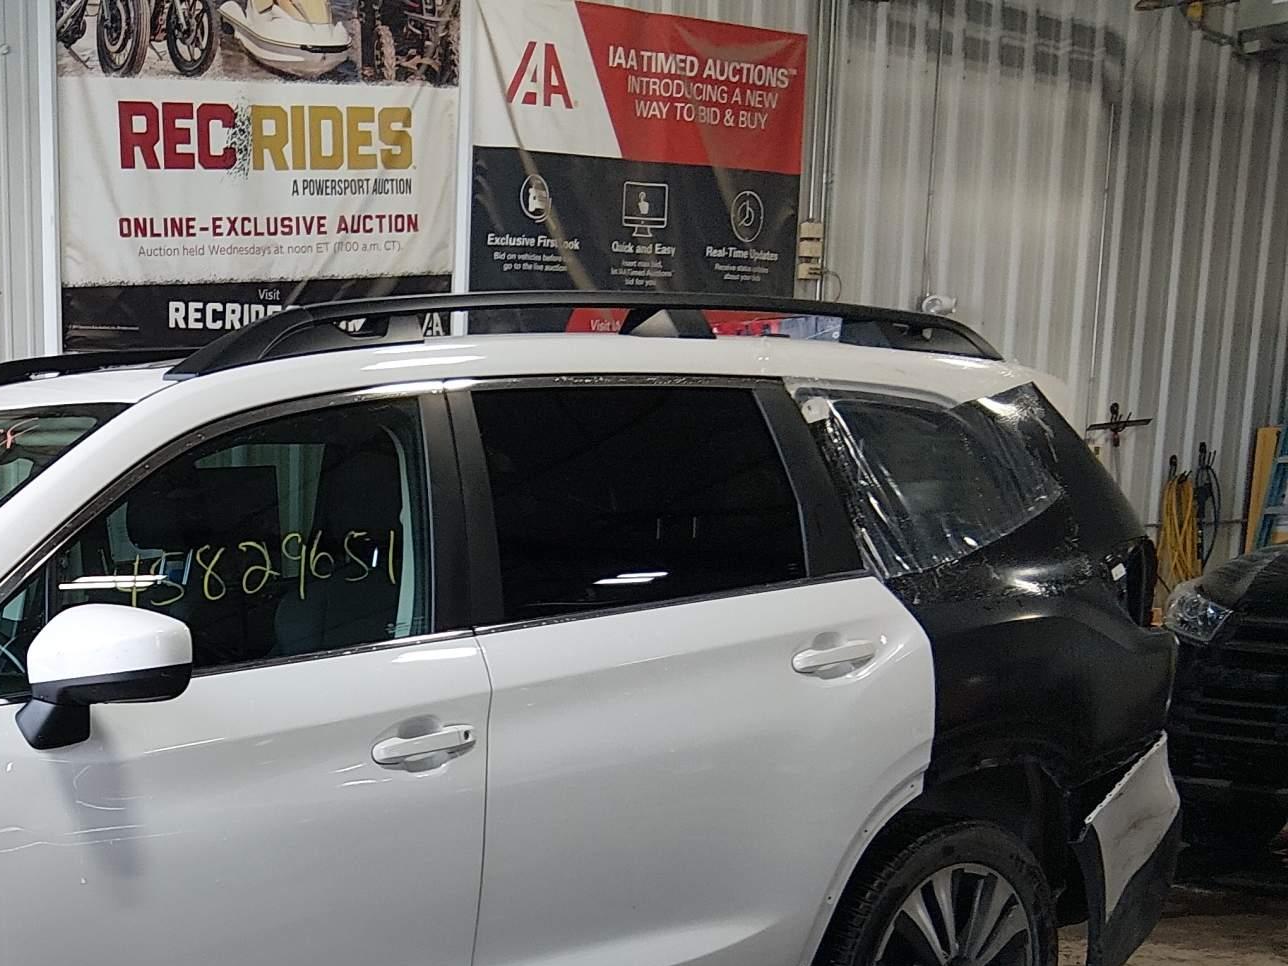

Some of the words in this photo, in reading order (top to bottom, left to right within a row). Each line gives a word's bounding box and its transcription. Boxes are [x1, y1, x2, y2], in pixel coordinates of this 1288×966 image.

[608, 46, 638, 70] IAA
[640, 51, 698, 77] TIMED
[627, 75, 728, 104] INTRODUCING
[731, 87, 742, 105] A
[745, 90, 779, 109] NEW
[635, 99, 671, 120] WAY
[674, 102, 696, 122] TO
[697, 106, 720, 125] BID
[723, 110, 735, 127] &
[739, 111, 768, 129] BUY
[249, 104, 414, 171] RIDES
[292, 178, 300, 196] A
[302, 178, 371, 196] POWERSPORT
[372, 178, 413, 195] AUCTION
[118, 215, 328, 238] ONLINE-EXCLUSIVE
[336, 214, 420, 234] AUCTION
[138, 245, 179, 257] Auction
[182, 244, 205, 256] held
[209, 243, 272, 257] Wednesdays
[273, 245, 283, 255] at
[287, 245, 313, 254] noon
[316, 242, 330, 253] ET
[487, 233, 536, 247] Exclusive
[562, 238, 580, 250] ook
[611, 240, 634, 253] Quick
[636, 243, 653, 254] and
[655, 243, 676, 257] Easy
[705, 246, 749, 259] Real-Time
[749, 249, 779, 261] Updates
[258, 289, 280, 301] Visit
[590, 319, 610, 332] Visit
